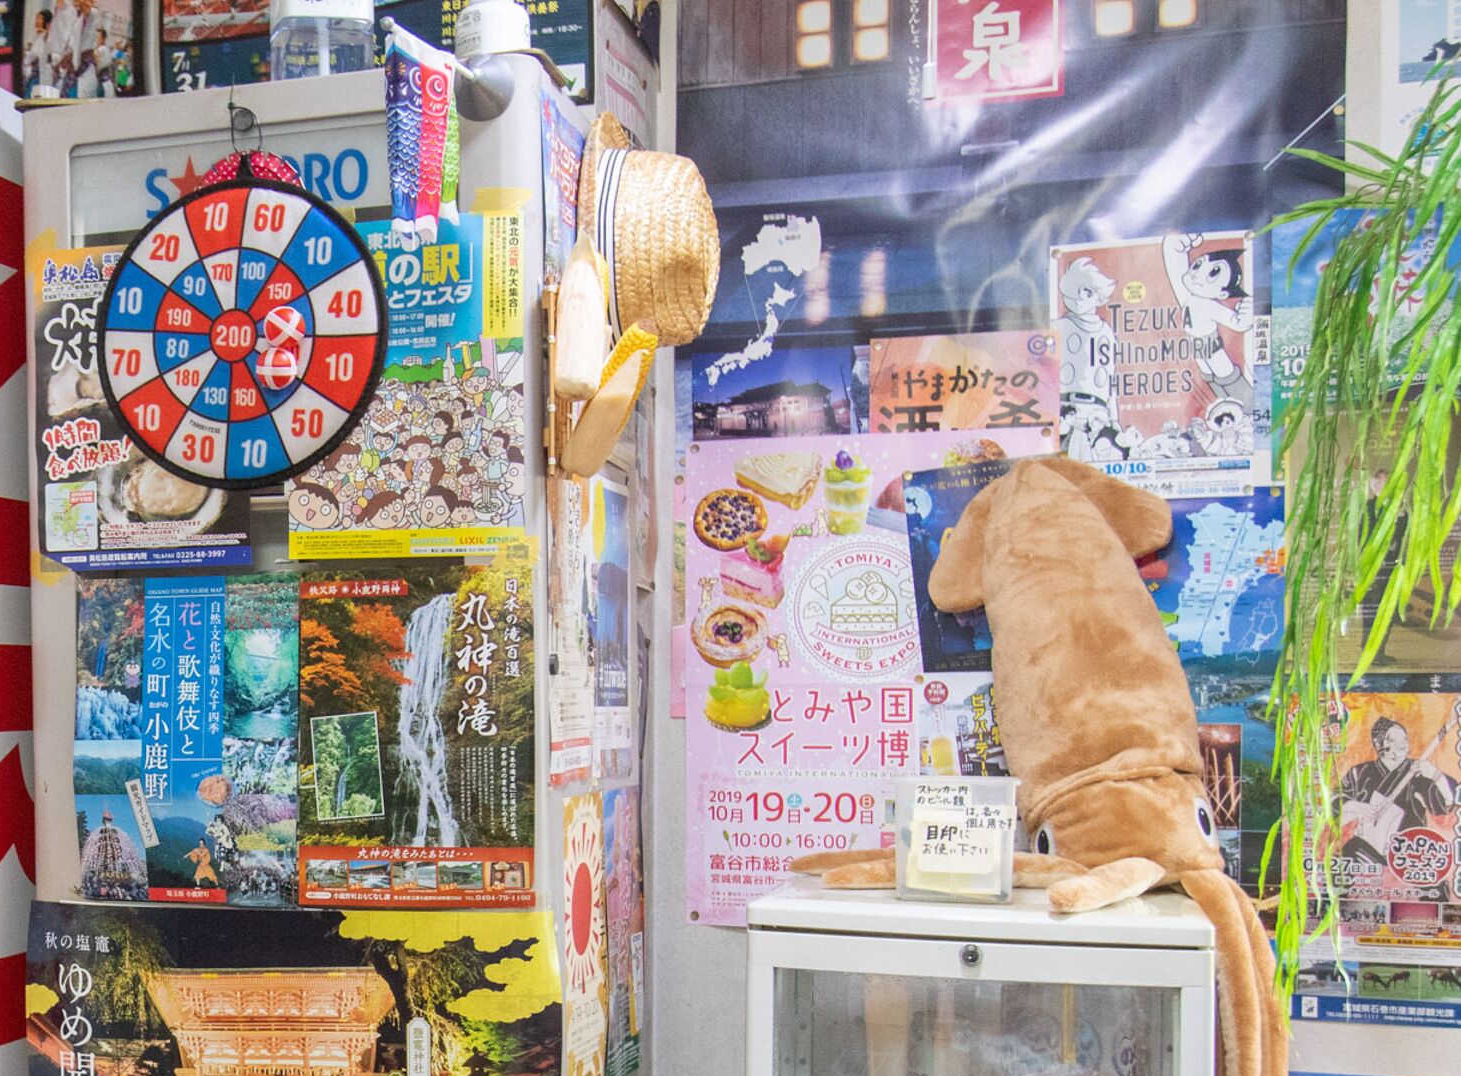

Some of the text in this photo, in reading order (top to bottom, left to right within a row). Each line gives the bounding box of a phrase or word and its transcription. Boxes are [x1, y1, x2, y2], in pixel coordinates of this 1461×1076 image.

[953, 1, 1028, 81] 泉
[203, 202, 229, 232] 10
[254, 203, 285, 232] 60
[149, 234, 180, 262] 20
[304, 236, 332, 265] 10
[43, 255, 100, 284] 奥松島
[211, 263, 233, 282] 170
[241, 262, 266, 281] 100
[183, 276, 207, 296] 90
[267, 282, 292, 301] 150
[116, 287, 142, 315] 10
[327, 290, 363, 318] 40
[166, 308, 192, 327] 190
[425, 313, 457, 329] 開催!
[1108, 305, 1193, 333] TEZUKA
[215, 326, 251, 347] 200
[165, 339, 189, 359] 80
[111, 349, 140, 377] 70
[326, 353, 354, 381] 10
[174, 368, 200, 388] 180
[1108, 370, 1193, 397] HEROES
[203, 387, 227, 406] 130
[233, 388, 256, 407] 160
[134, 404, 161, 431] 10
[291, 409, 324, 439] 50
[46, 437, 133, 480] 食べ放題!
[182, 434, 216, 464] 30
[241, 439, 267, 468] 10
[1105, 463, 1147, 475] 10/10
[459, 536, 484, 545] LIXIL
[834, 553, 892, 569] TOMIYA
[189, 587, 208, 595] GUIDE
[209, 586, 224, 594] MAP
[308, 584, 339, 597] 秩父路
[503, 578, 523, 678] 日本の滝百選
[817, 629, 914, 646] INTERNATIONAL
[455, 593, 499, 739] 丸神の滝
[813, 640, 873, 671] SWEETS
[879, 640, 916, 669] EXPO
[176, 601, 202, 757] 花と歌舞伎と
[208, 600, 223, 736] 自然・文化が織りなす四季
[771, 687, 914, 724] とみや国
[736, 731, 911, 768] スイーツ博
[737, 769, 784, 778] TOMIYA
[707, 791, 858, 824] 10月 19 20
[708, 790, 743, 804] 2019
[731, 831, 848, 850] 10:00 16:00
[926, 825, 970, 842] 目印に
[1392, 835, 1451, 854] JAPAN
[921, 843, 989, 857] お使い下さい
[1394, 856, 1447, 870] フェスタ
[1403, 871, 1437, 882] 2019
[44, 931, 111, 954] 秋の塩竈
